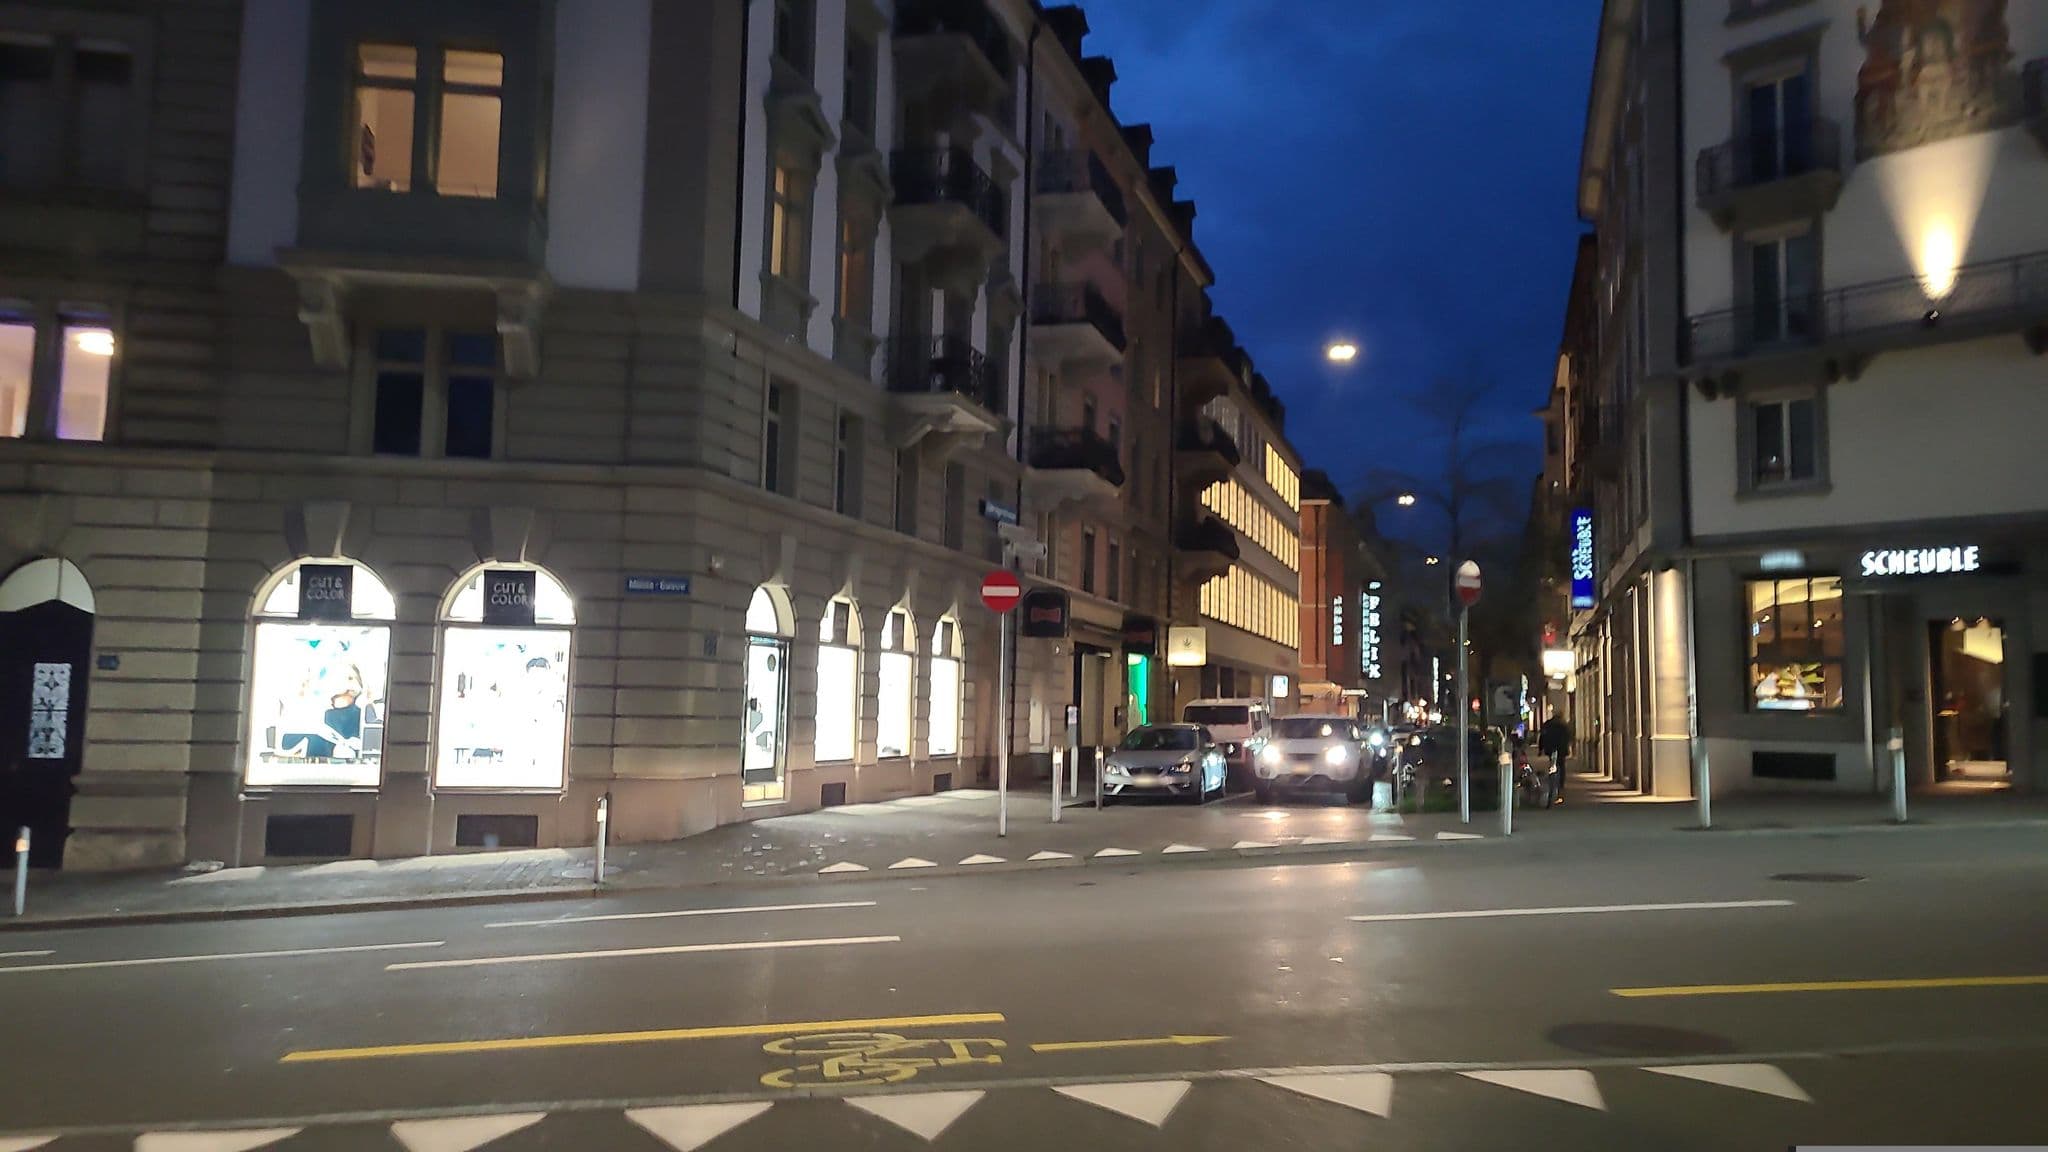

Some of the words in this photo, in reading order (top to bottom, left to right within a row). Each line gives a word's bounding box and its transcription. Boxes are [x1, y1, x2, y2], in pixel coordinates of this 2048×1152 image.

[1861, 546, 1980, 576] SCHEUBLE
[307, 588, 345, 599] COLOR
[494, 583, 515, 594] CUT
[492, 594, 527, 605] COLOR
